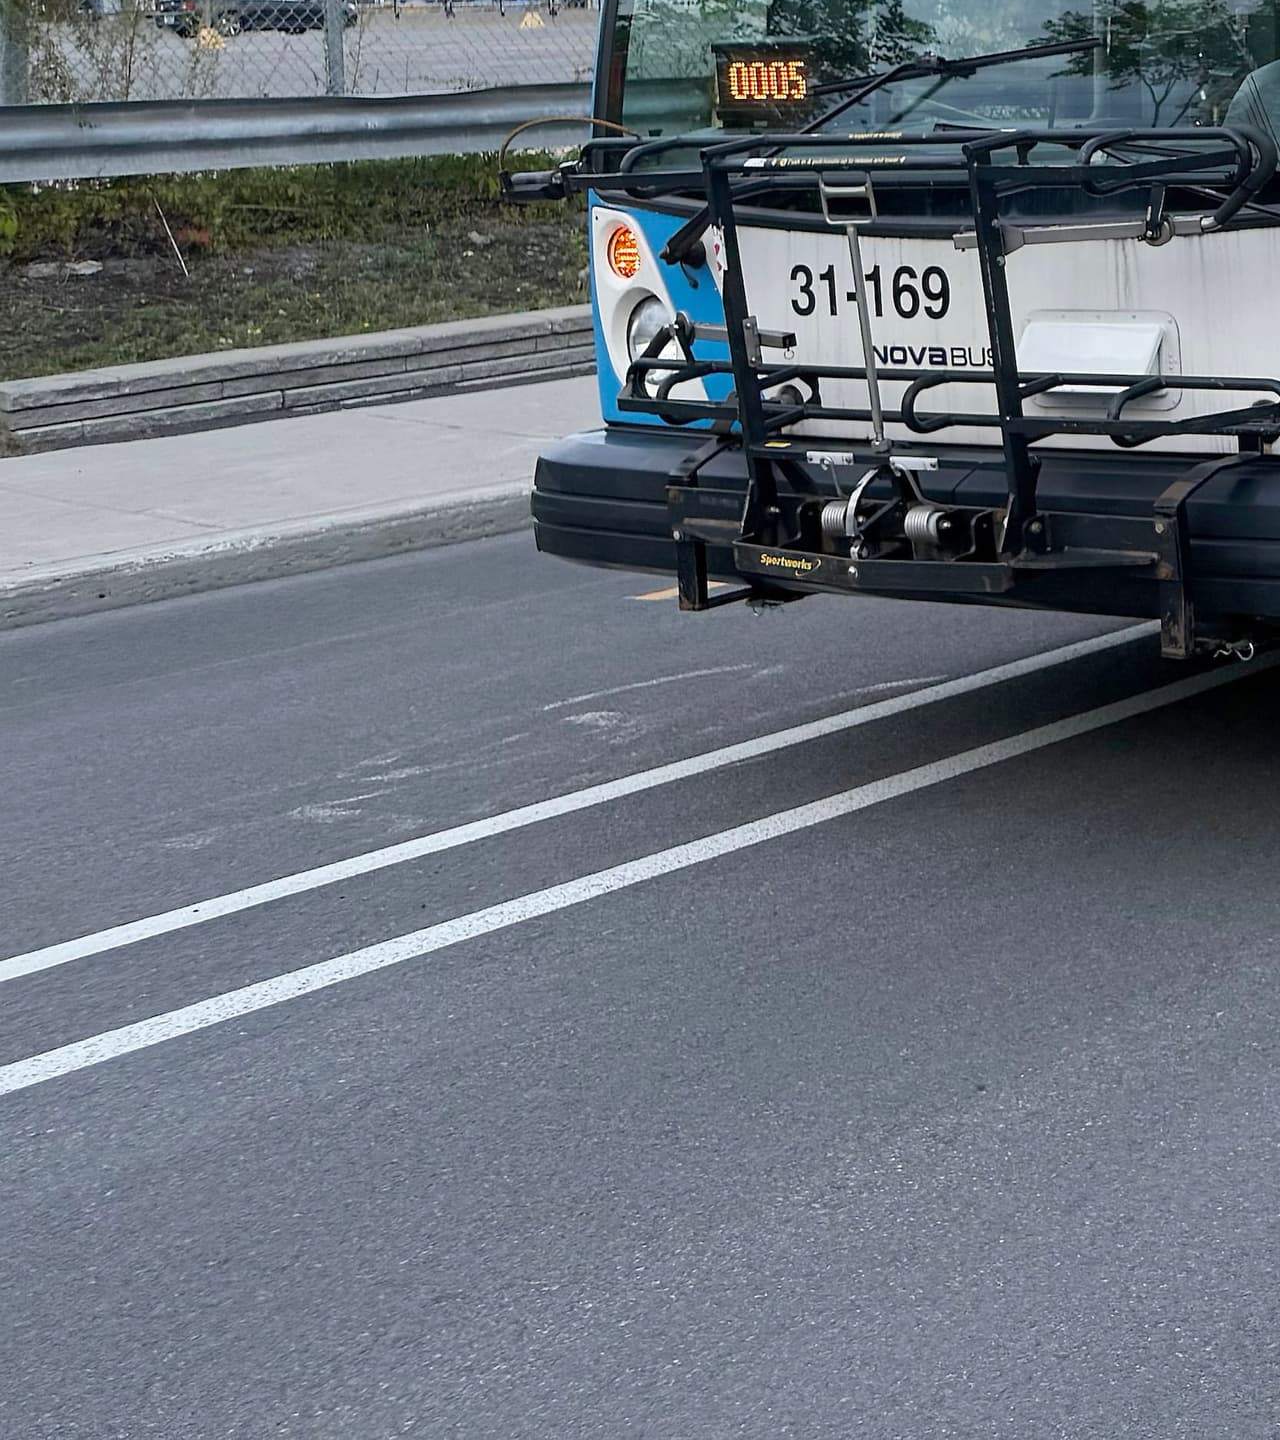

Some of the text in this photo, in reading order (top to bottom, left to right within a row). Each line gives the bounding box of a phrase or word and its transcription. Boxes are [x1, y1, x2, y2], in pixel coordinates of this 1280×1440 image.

[728, 61, 807, 100] 0005
[790, 264, 951, 320] 31-169
[760, 553, 813, 570] Sportworks
